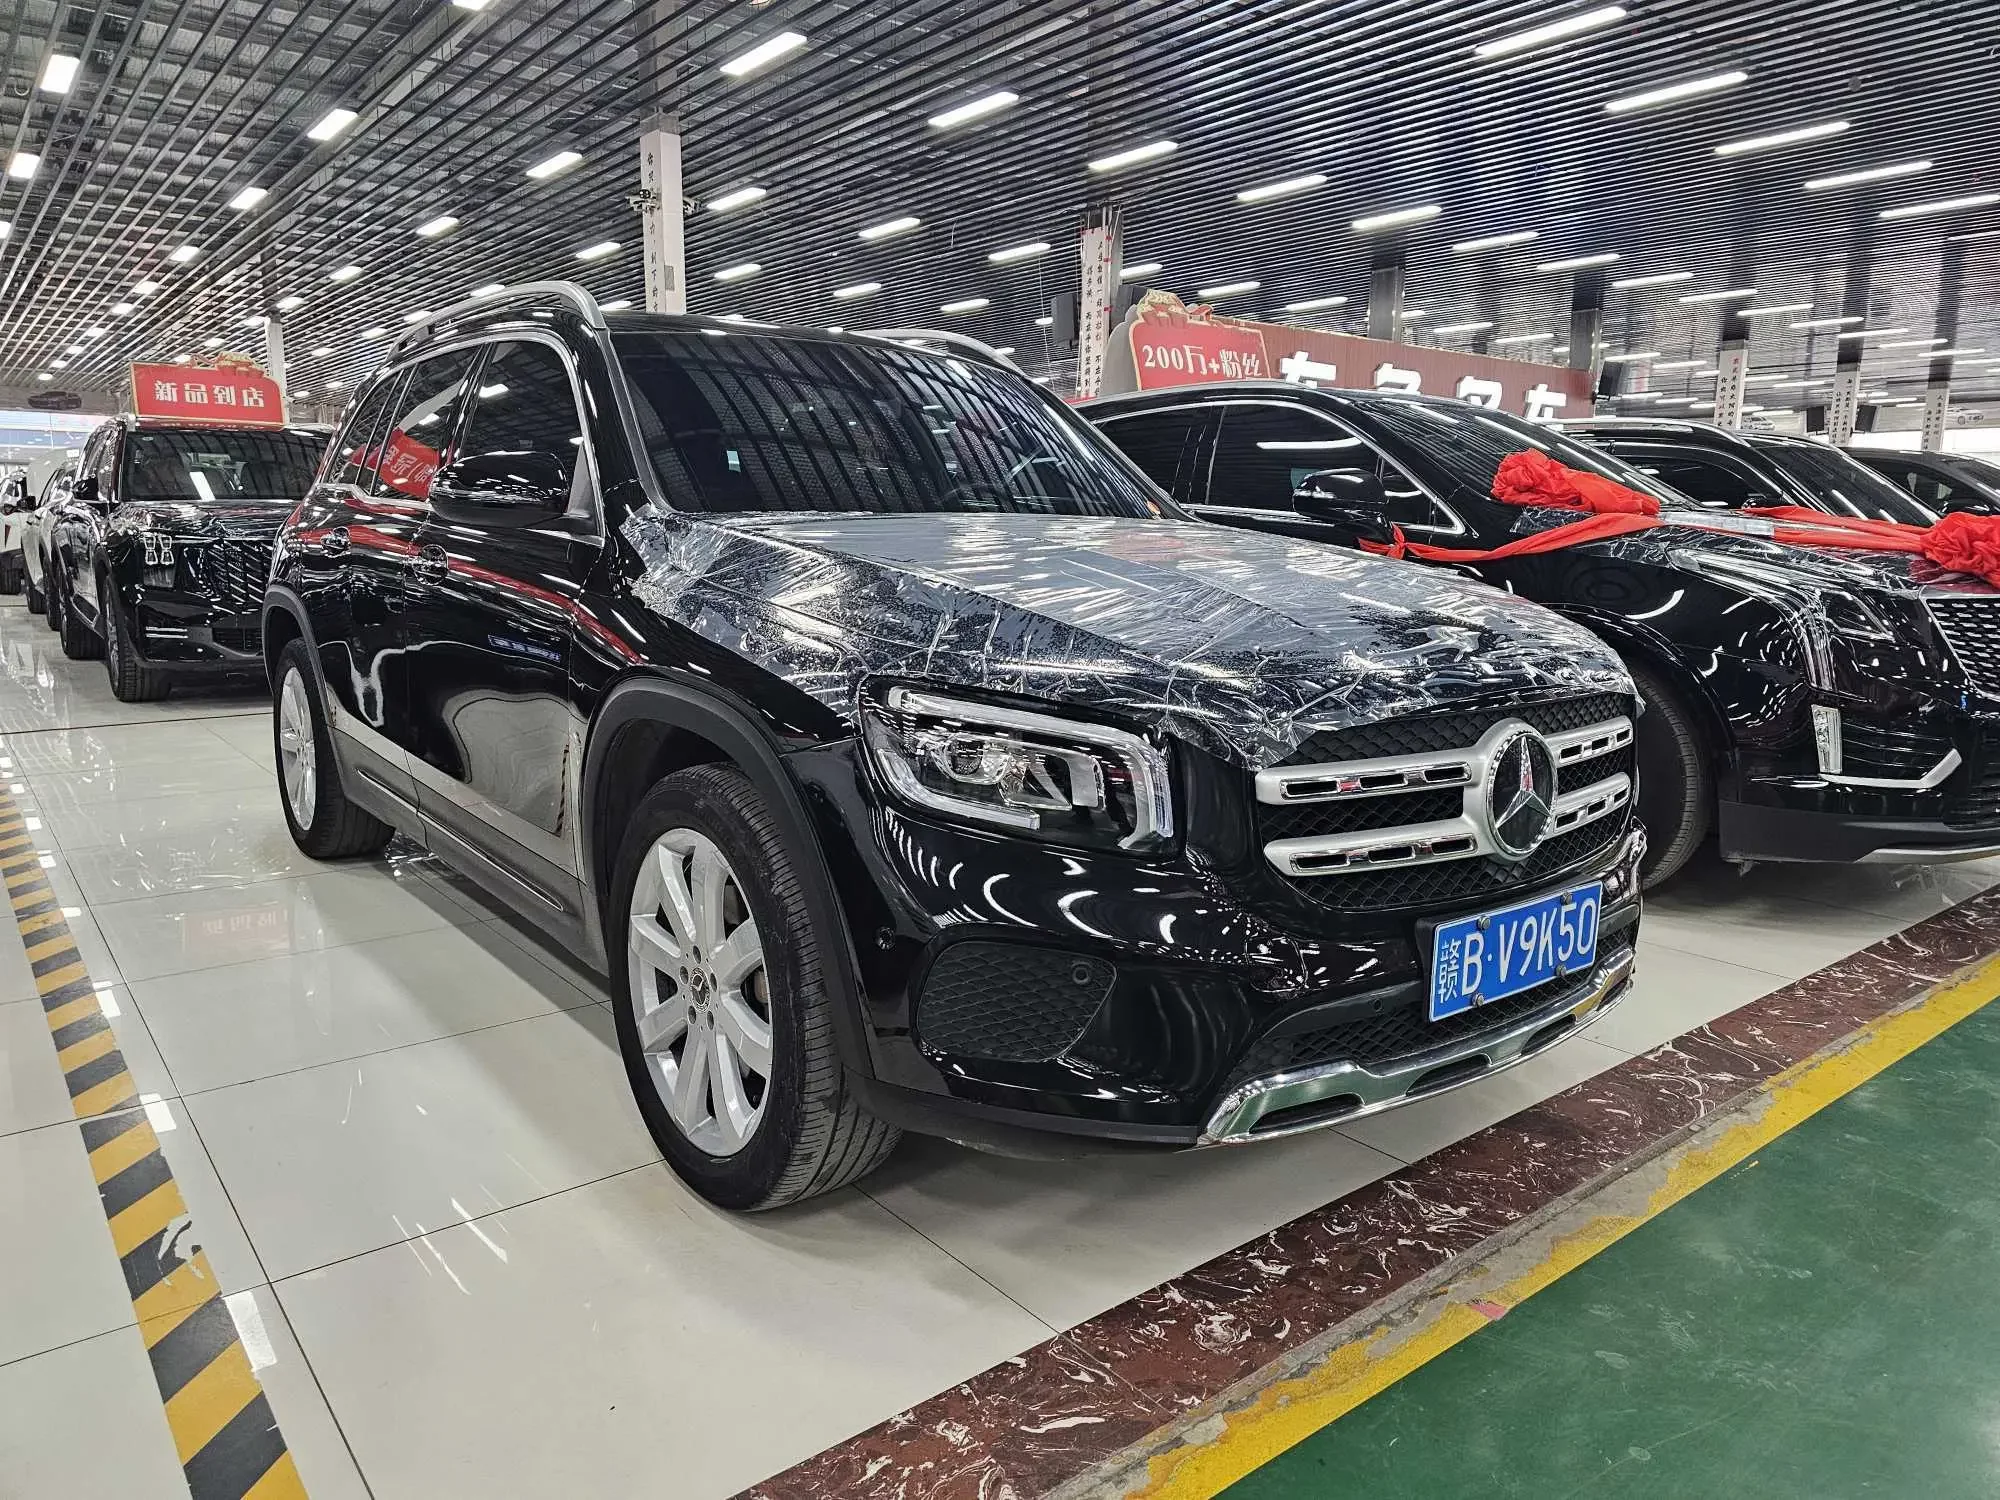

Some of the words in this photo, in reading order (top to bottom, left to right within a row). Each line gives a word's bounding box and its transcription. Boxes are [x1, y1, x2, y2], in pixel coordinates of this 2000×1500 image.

[1142, 344, 1262, 379] 200万+粉丝
[154, 380, 265, 408] 新品到店
